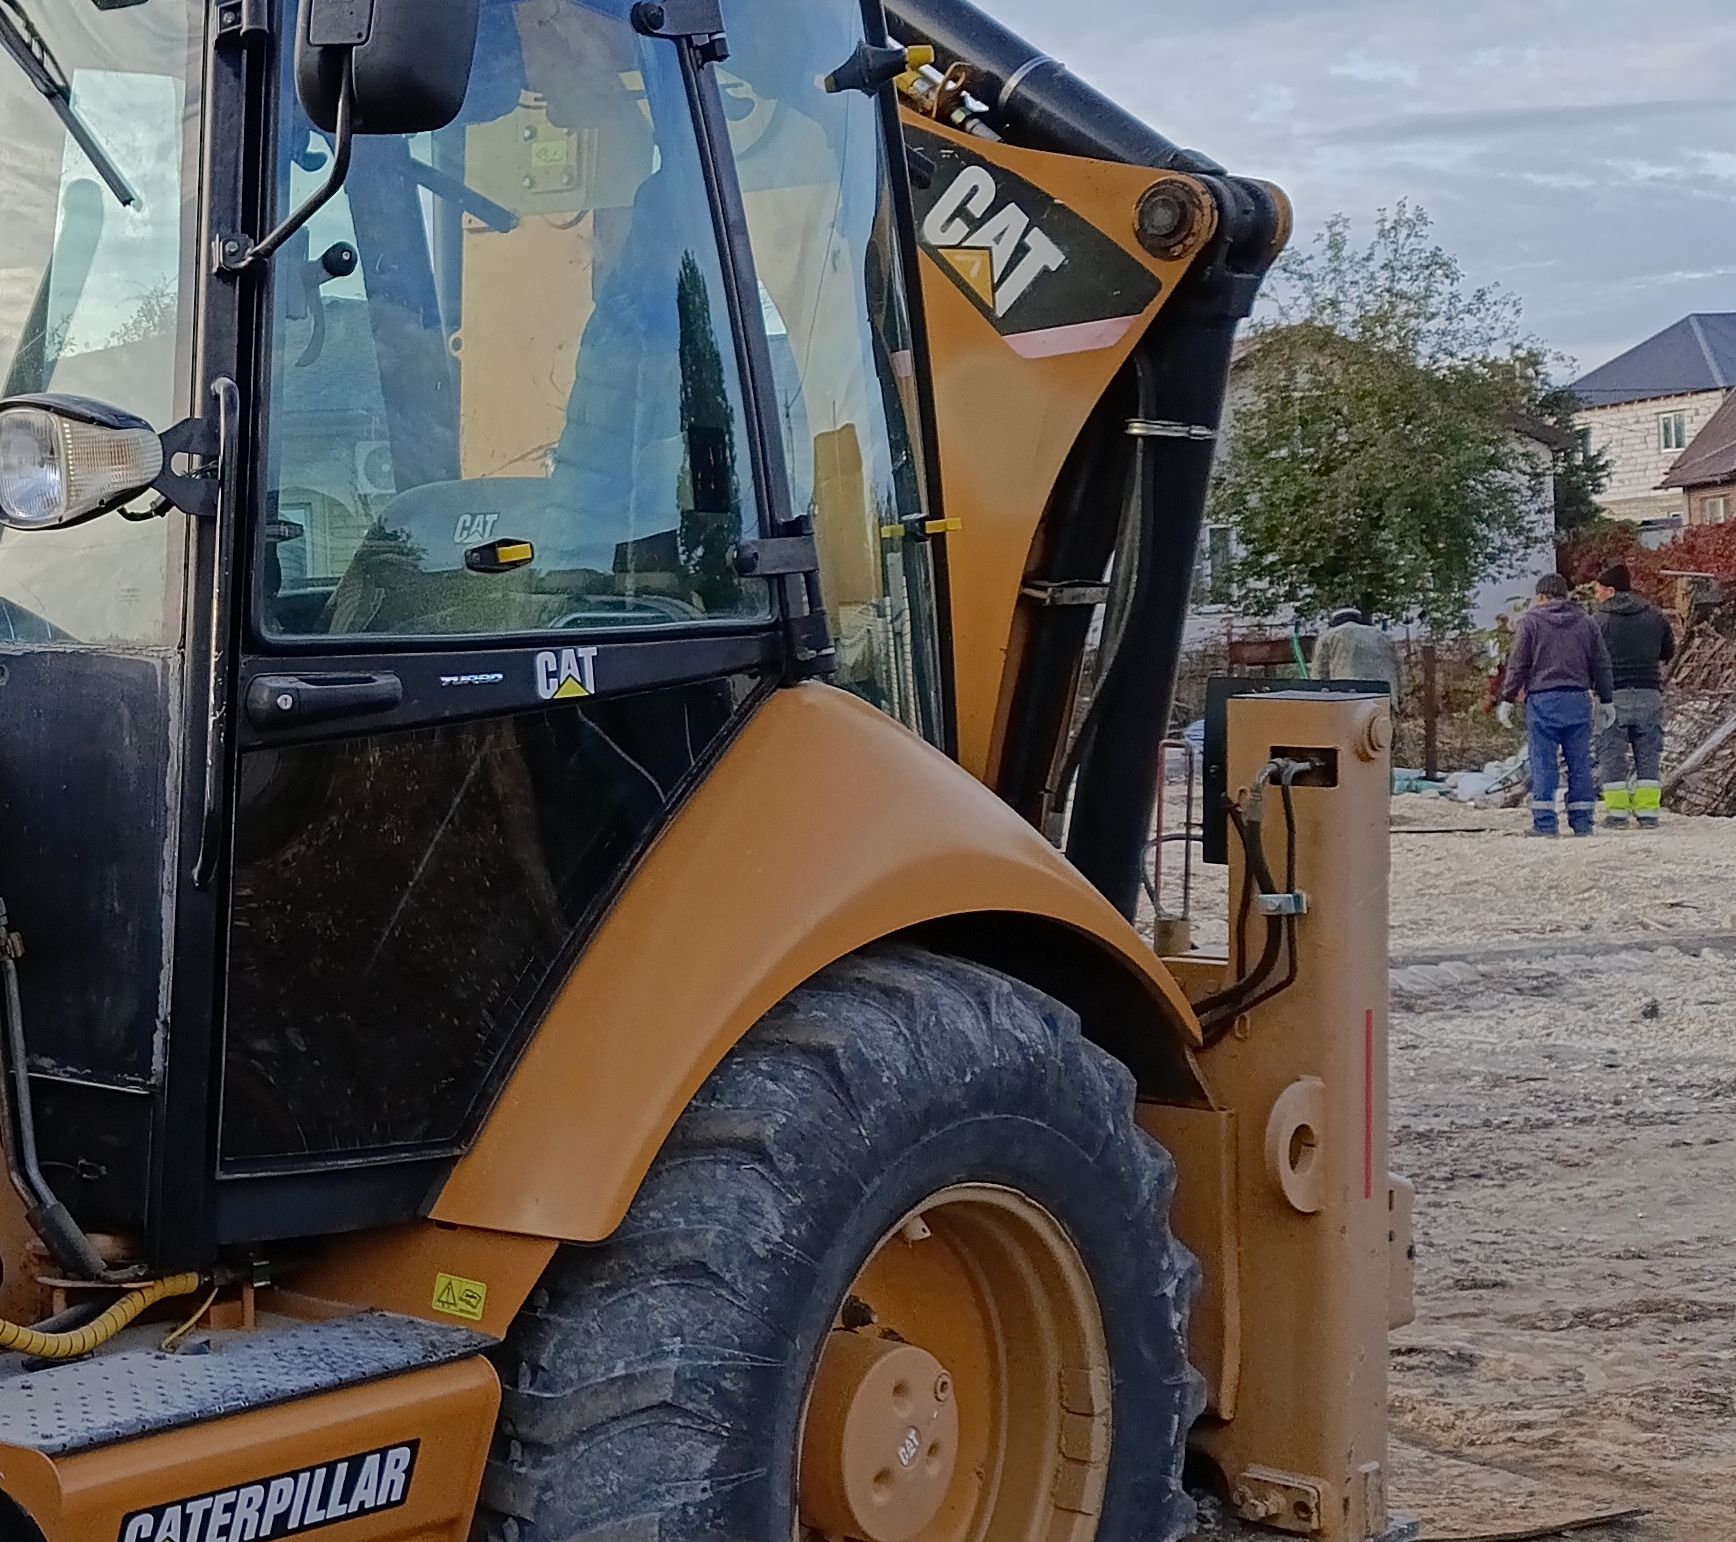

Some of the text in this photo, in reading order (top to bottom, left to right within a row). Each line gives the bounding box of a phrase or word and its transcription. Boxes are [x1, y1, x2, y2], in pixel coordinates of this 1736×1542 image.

[923, 165, 1065, 318] CAT
[454, 514, 499, 543] CAT
[536, 647, 598, 700] CAT
[899, 1428, 919, 1466] CAT
